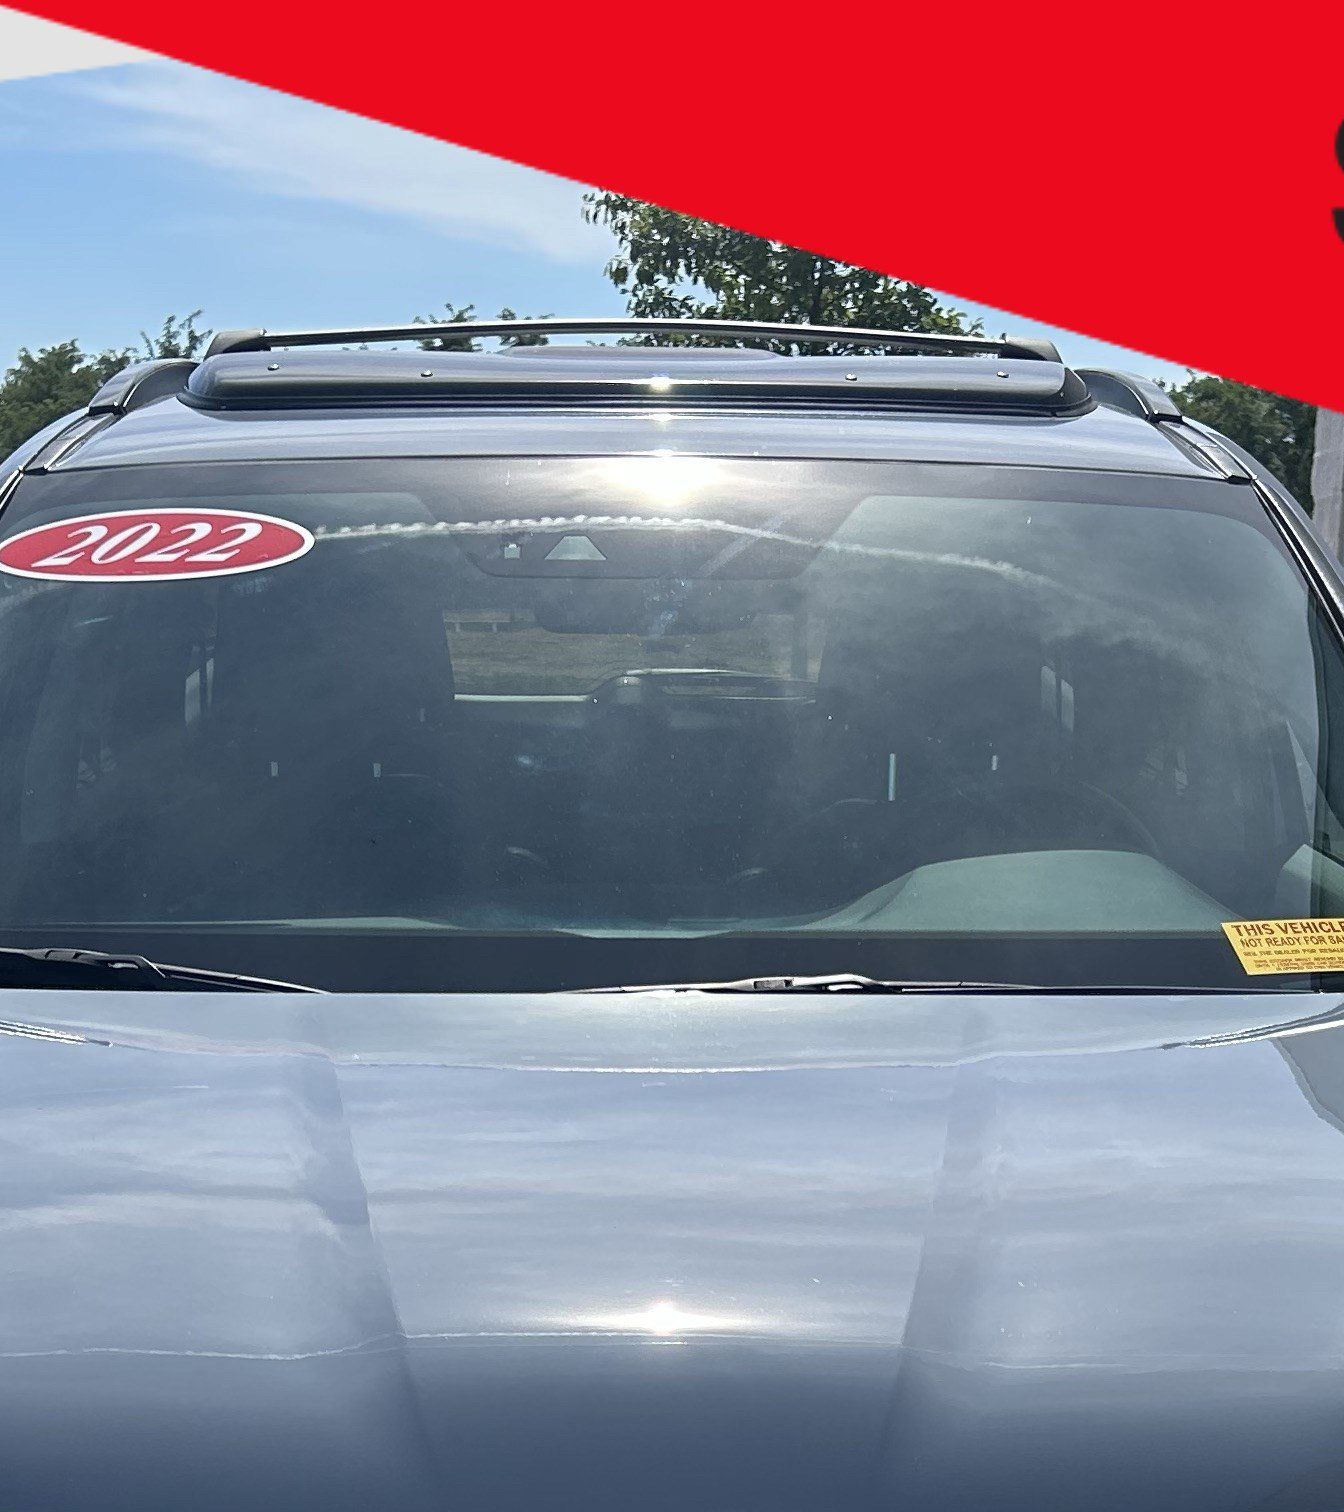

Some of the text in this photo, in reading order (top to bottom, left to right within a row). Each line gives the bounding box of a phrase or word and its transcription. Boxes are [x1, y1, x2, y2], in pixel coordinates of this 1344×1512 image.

[31, 522, 263, 568] 2022
[1231, 923, 1275, 936] THIS
[1240, 938, 1264, 948] NOT
[1266, 936, 1304, 948] READY
[1304, 936, 1327, 946] FOR
